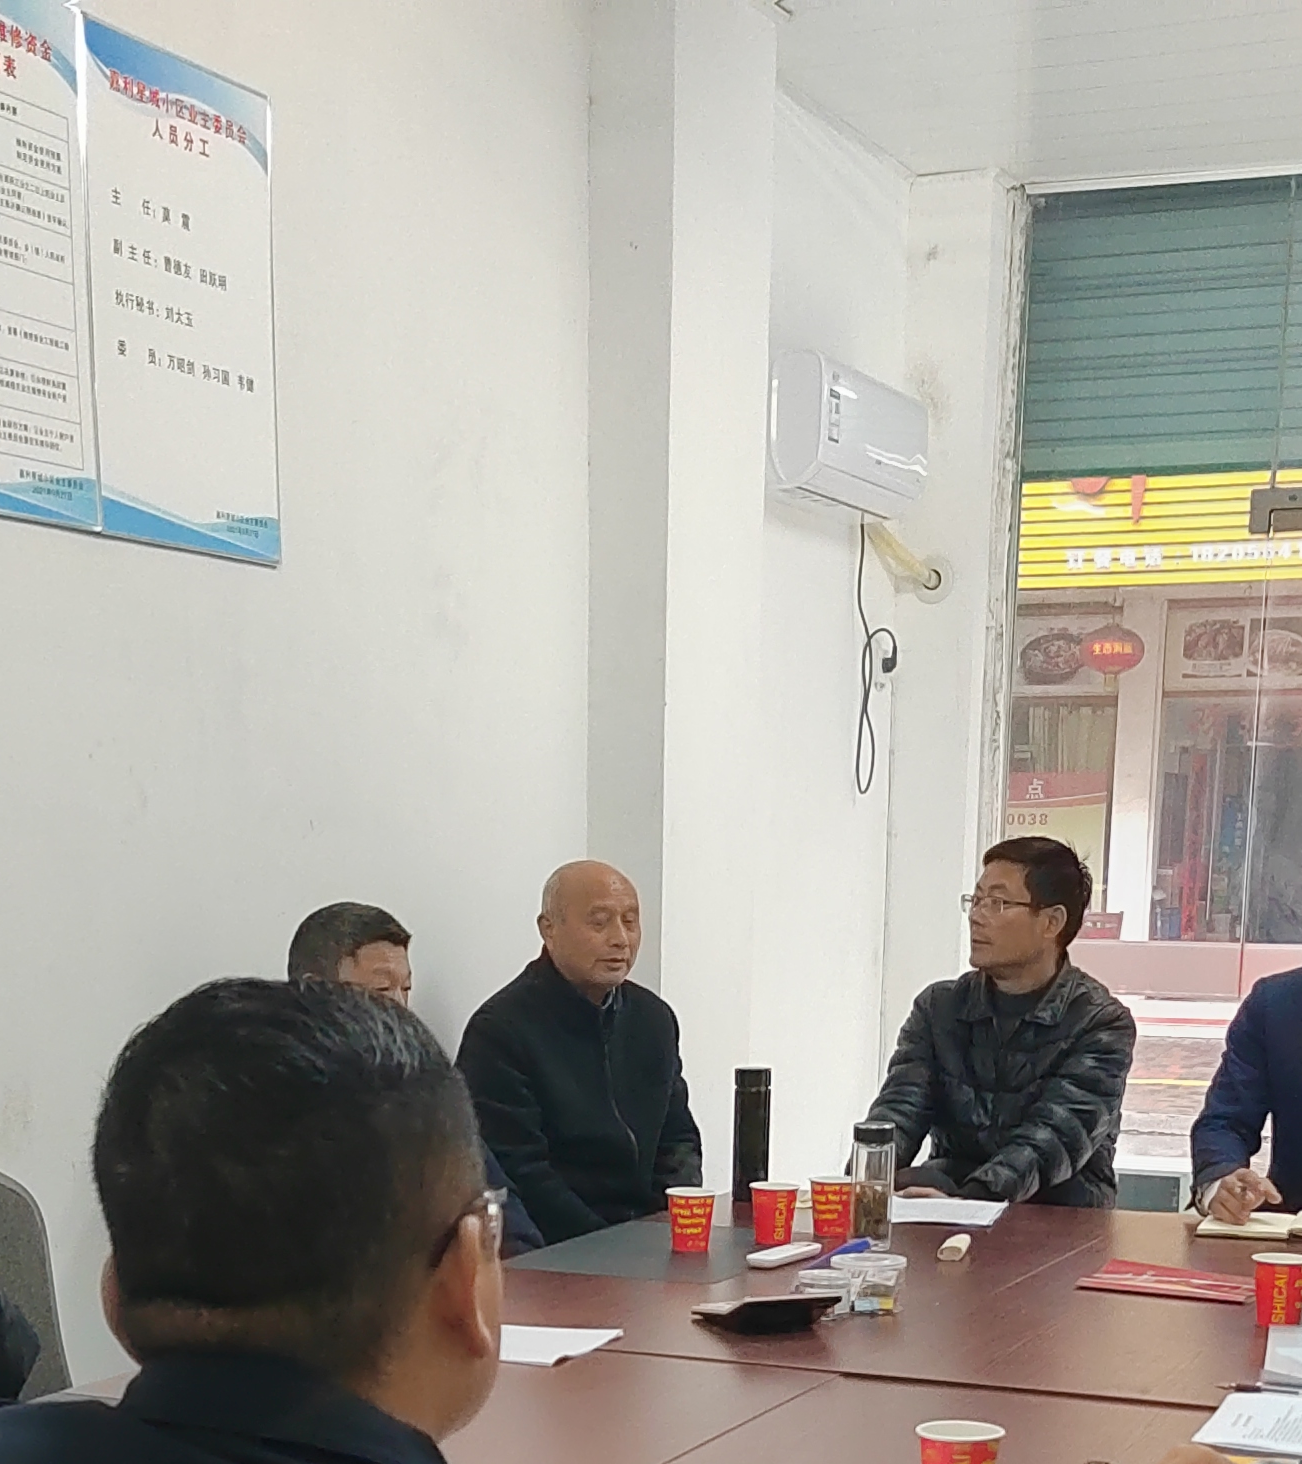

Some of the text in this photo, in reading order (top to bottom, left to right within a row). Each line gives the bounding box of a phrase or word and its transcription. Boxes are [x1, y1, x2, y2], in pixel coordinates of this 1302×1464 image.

[109, 68, 248, 145] 嘉利星城小区业主委员会
[152, 118, 210, 158] 人员分工
[1026, 778, 1044, 799] 点
